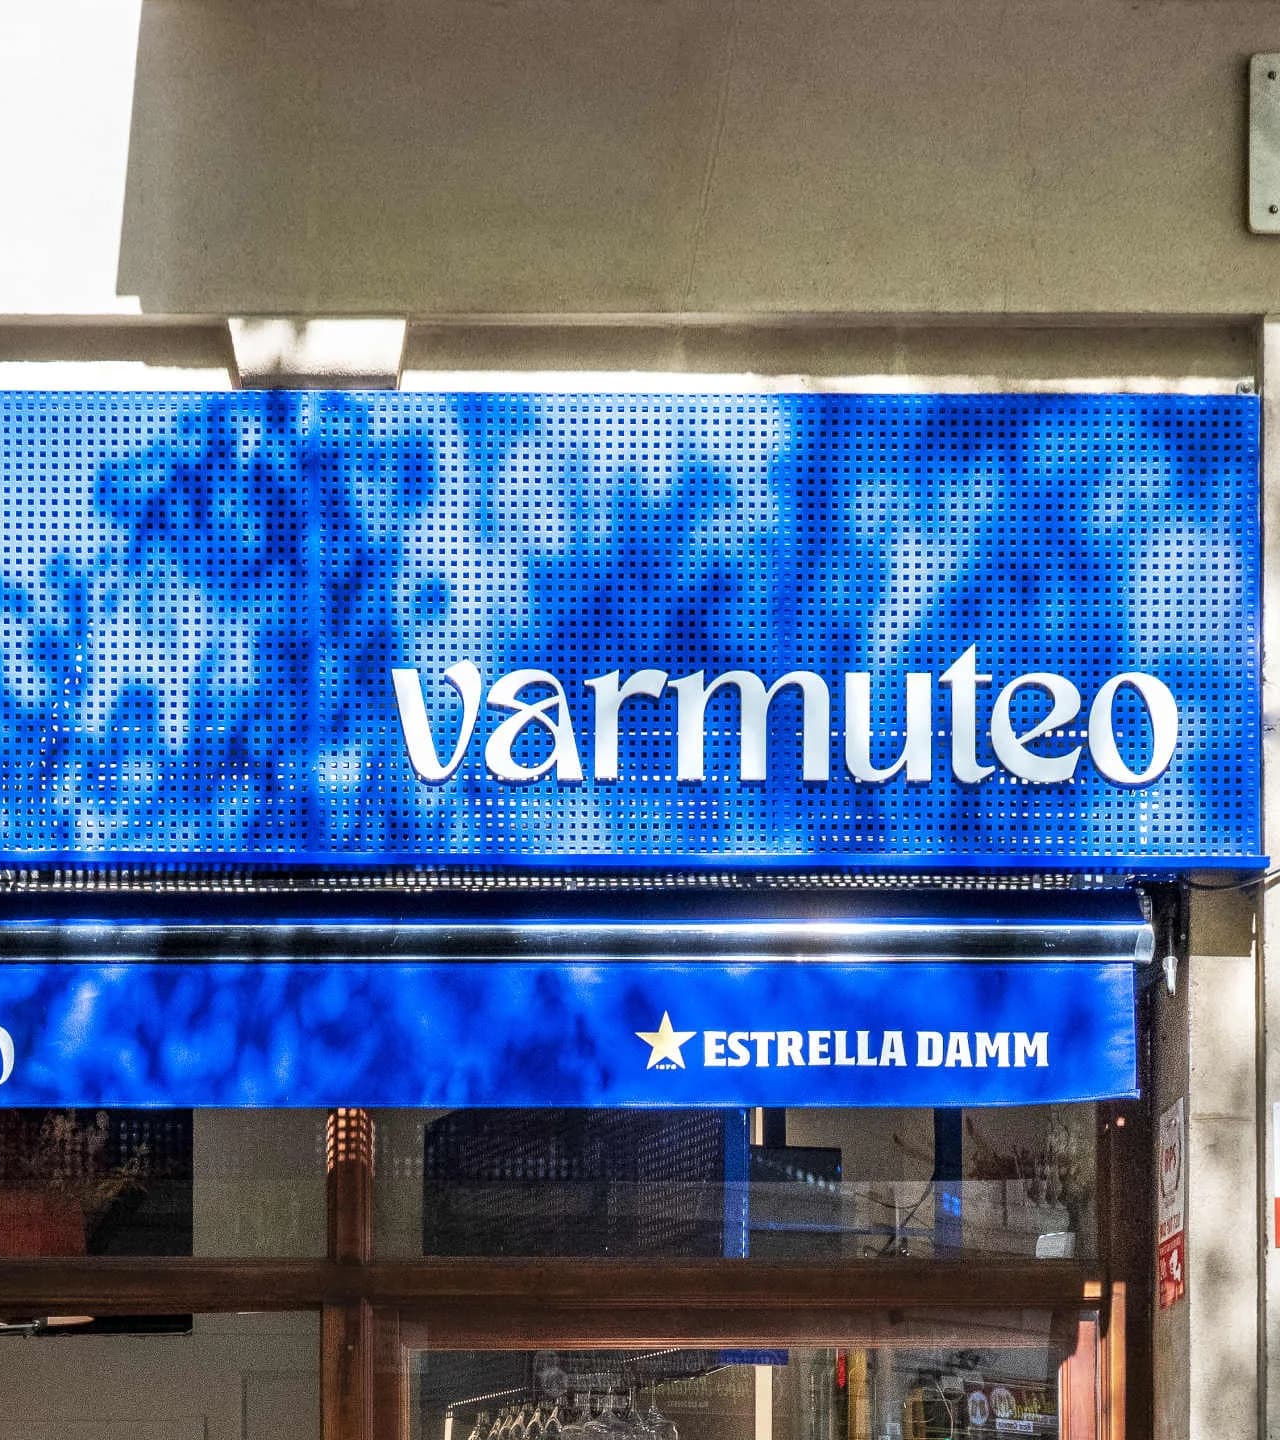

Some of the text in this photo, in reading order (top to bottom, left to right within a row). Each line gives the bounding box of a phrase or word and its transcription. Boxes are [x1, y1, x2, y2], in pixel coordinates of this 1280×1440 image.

[391, 643, 1179, 784] varmuteo
[703, 1030, 1050, 1067] ESTRELLA DAMM
